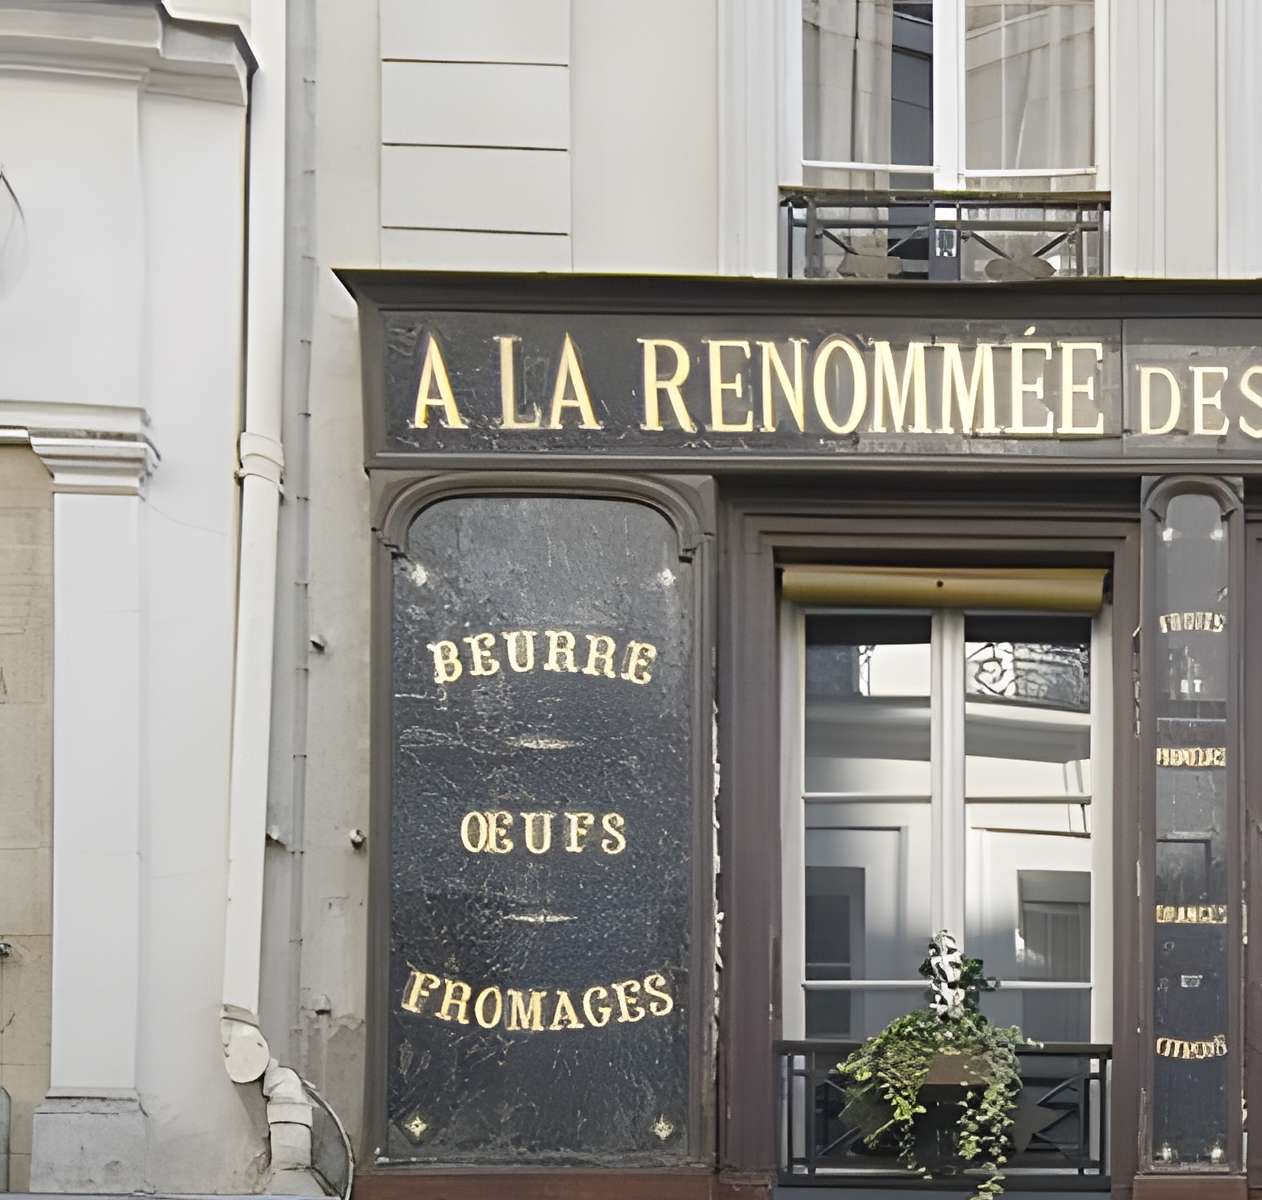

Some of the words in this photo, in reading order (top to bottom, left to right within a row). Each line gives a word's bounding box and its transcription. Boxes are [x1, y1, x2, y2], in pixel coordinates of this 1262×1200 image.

[408, 331, 468, 430] A
[494, 332, 602, 431] LA
[638, 326, 1104, 435] RENOMMÉE
[427, 630, 657, 685] BEURRE
[461, 811, 627, 855] ŒUFS
[400, 971, 674, 1032] FROMAGES
